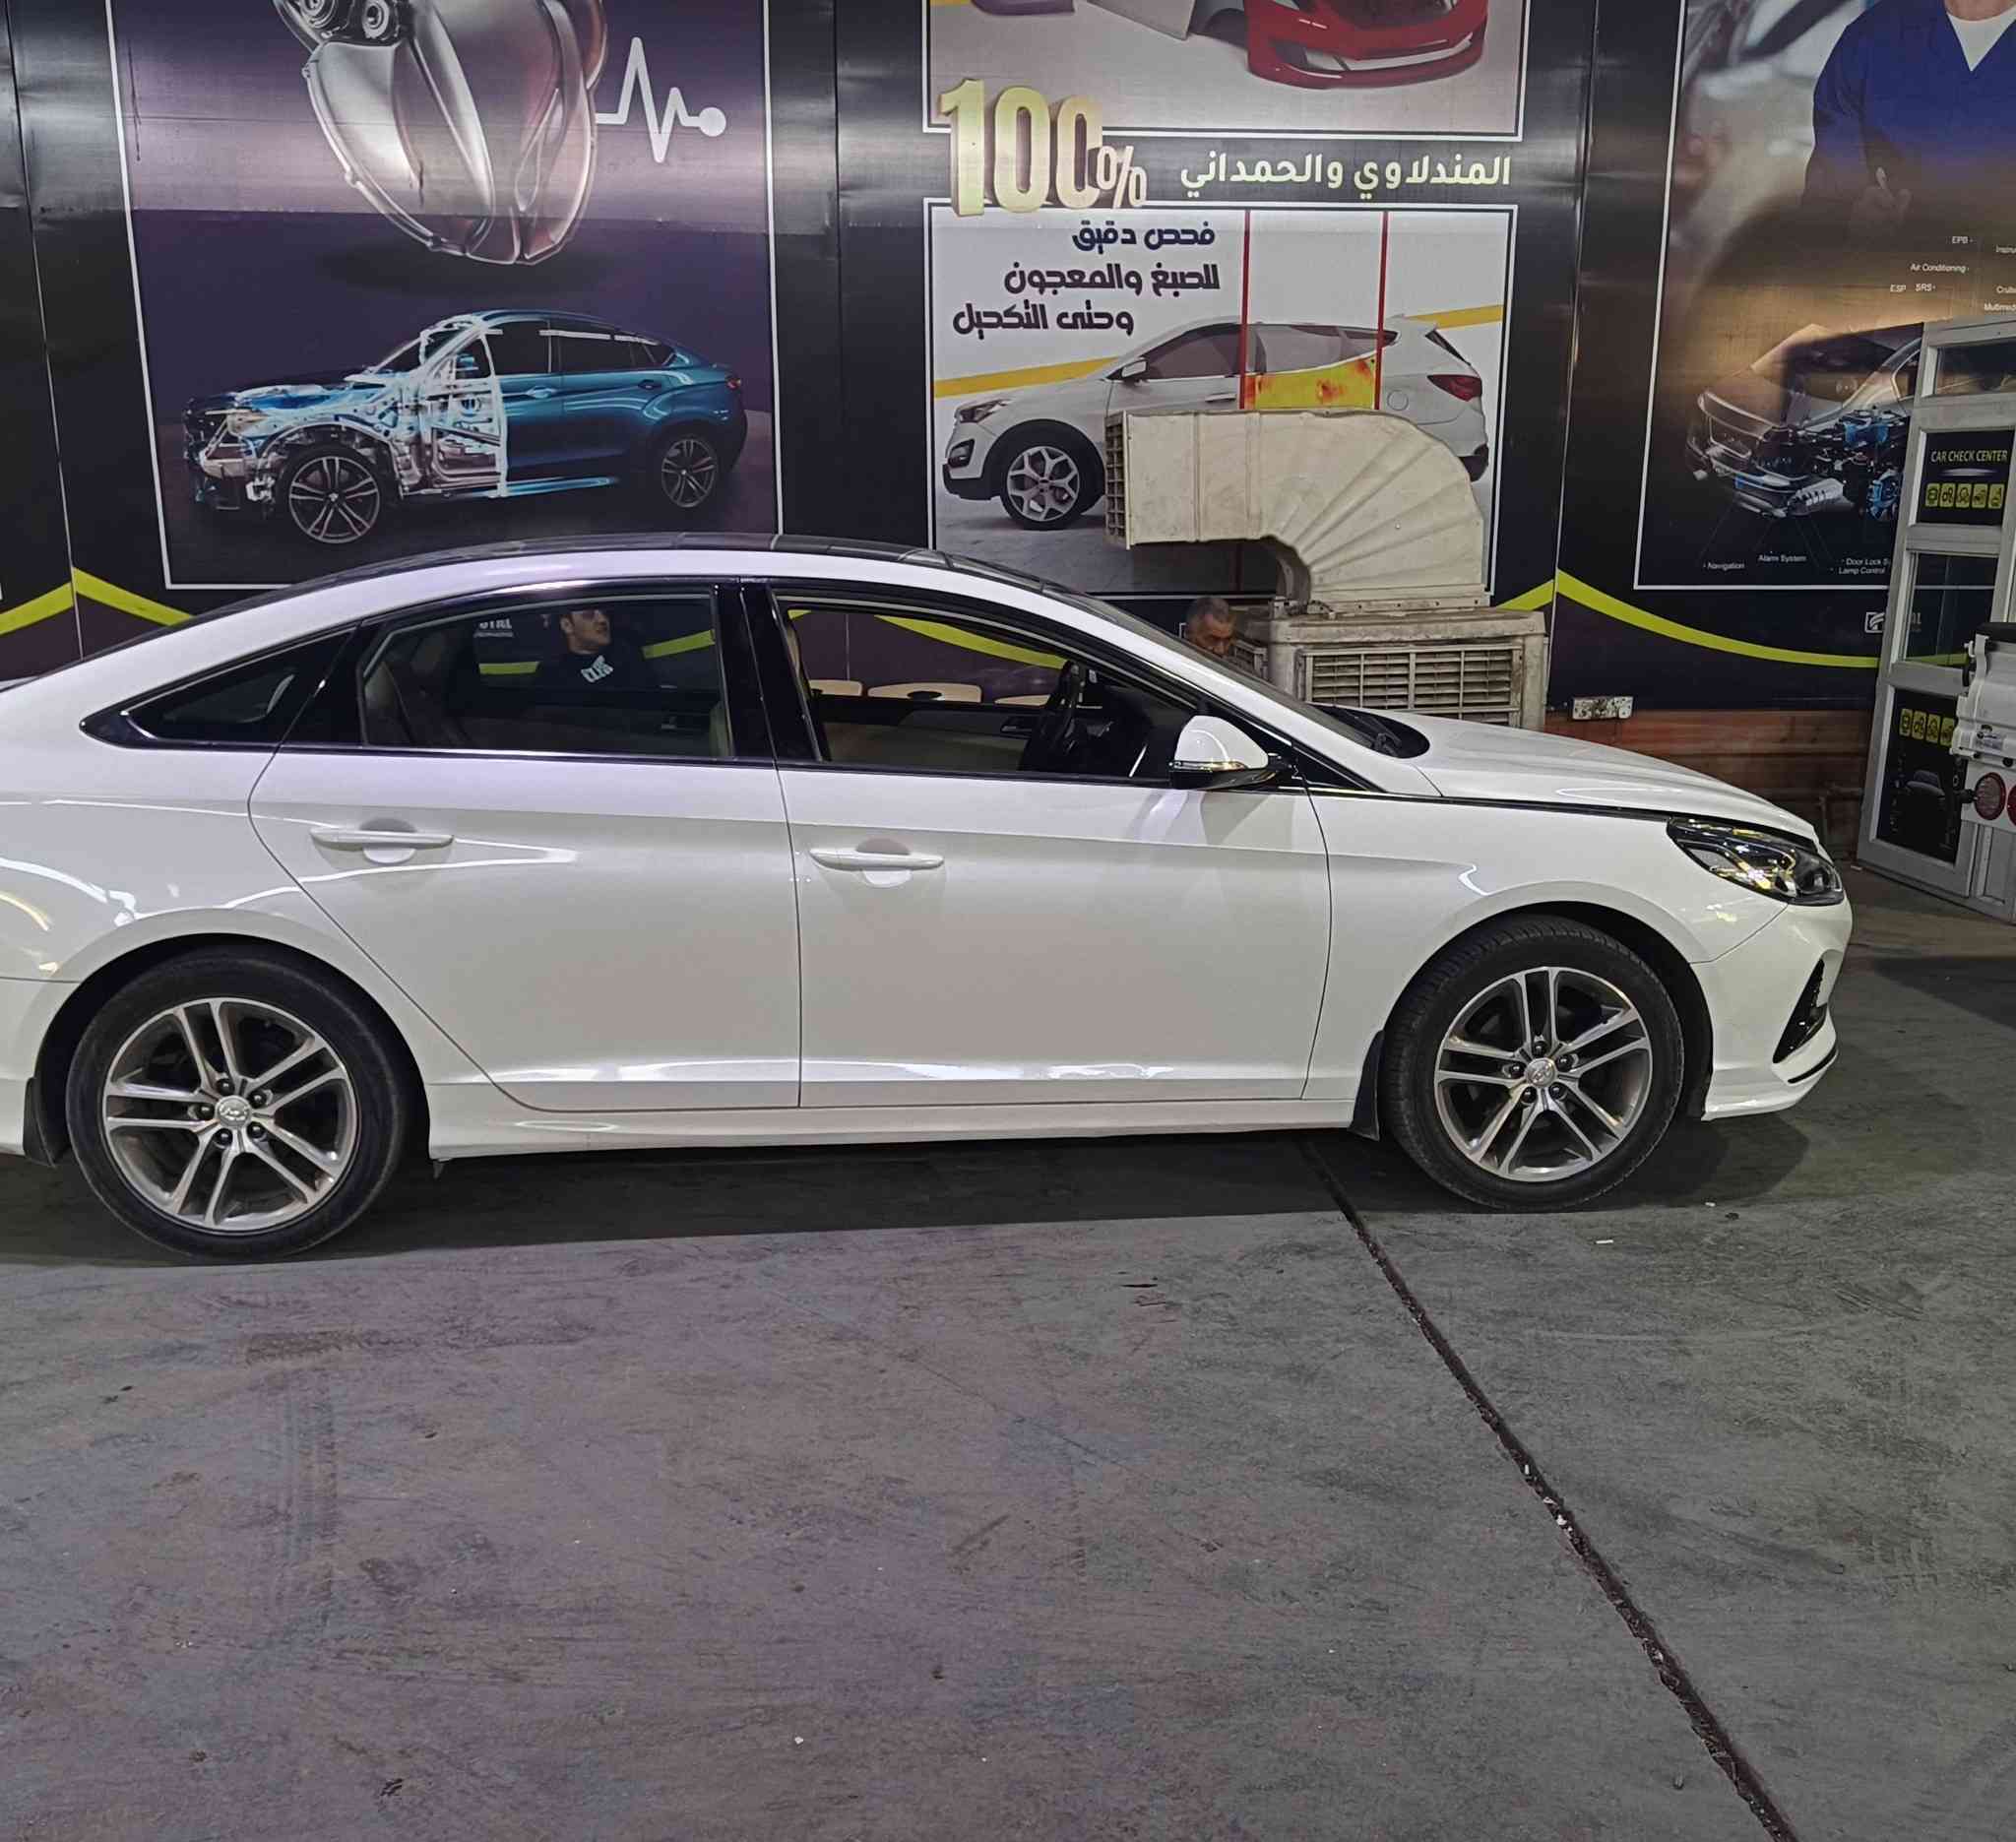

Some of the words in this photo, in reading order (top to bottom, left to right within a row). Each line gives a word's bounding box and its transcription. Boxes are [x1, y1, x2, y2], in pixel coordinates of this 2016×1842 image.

[938, 79, 1147, 217] 100%
[1180, 151, 1343, 198] والحمداني
[1354, 154, 1511, 200] المندلاوي
[1072, 221, 1137, 254] دقيق
[1144, 222, 1216, 250] فحص
[1004, 262, 1143, 295] والمعجون
[1151, 262, 1221, 297] للصبغ
[953, 299, 1048, 340] التكحيل
[1056, 299, 1134, 336] وحتى
[1930, 450, 1947, 464] CAR
[1948, 450, 1975, 463] CHECK
[1976, 449, 2008, 463] CENTER
